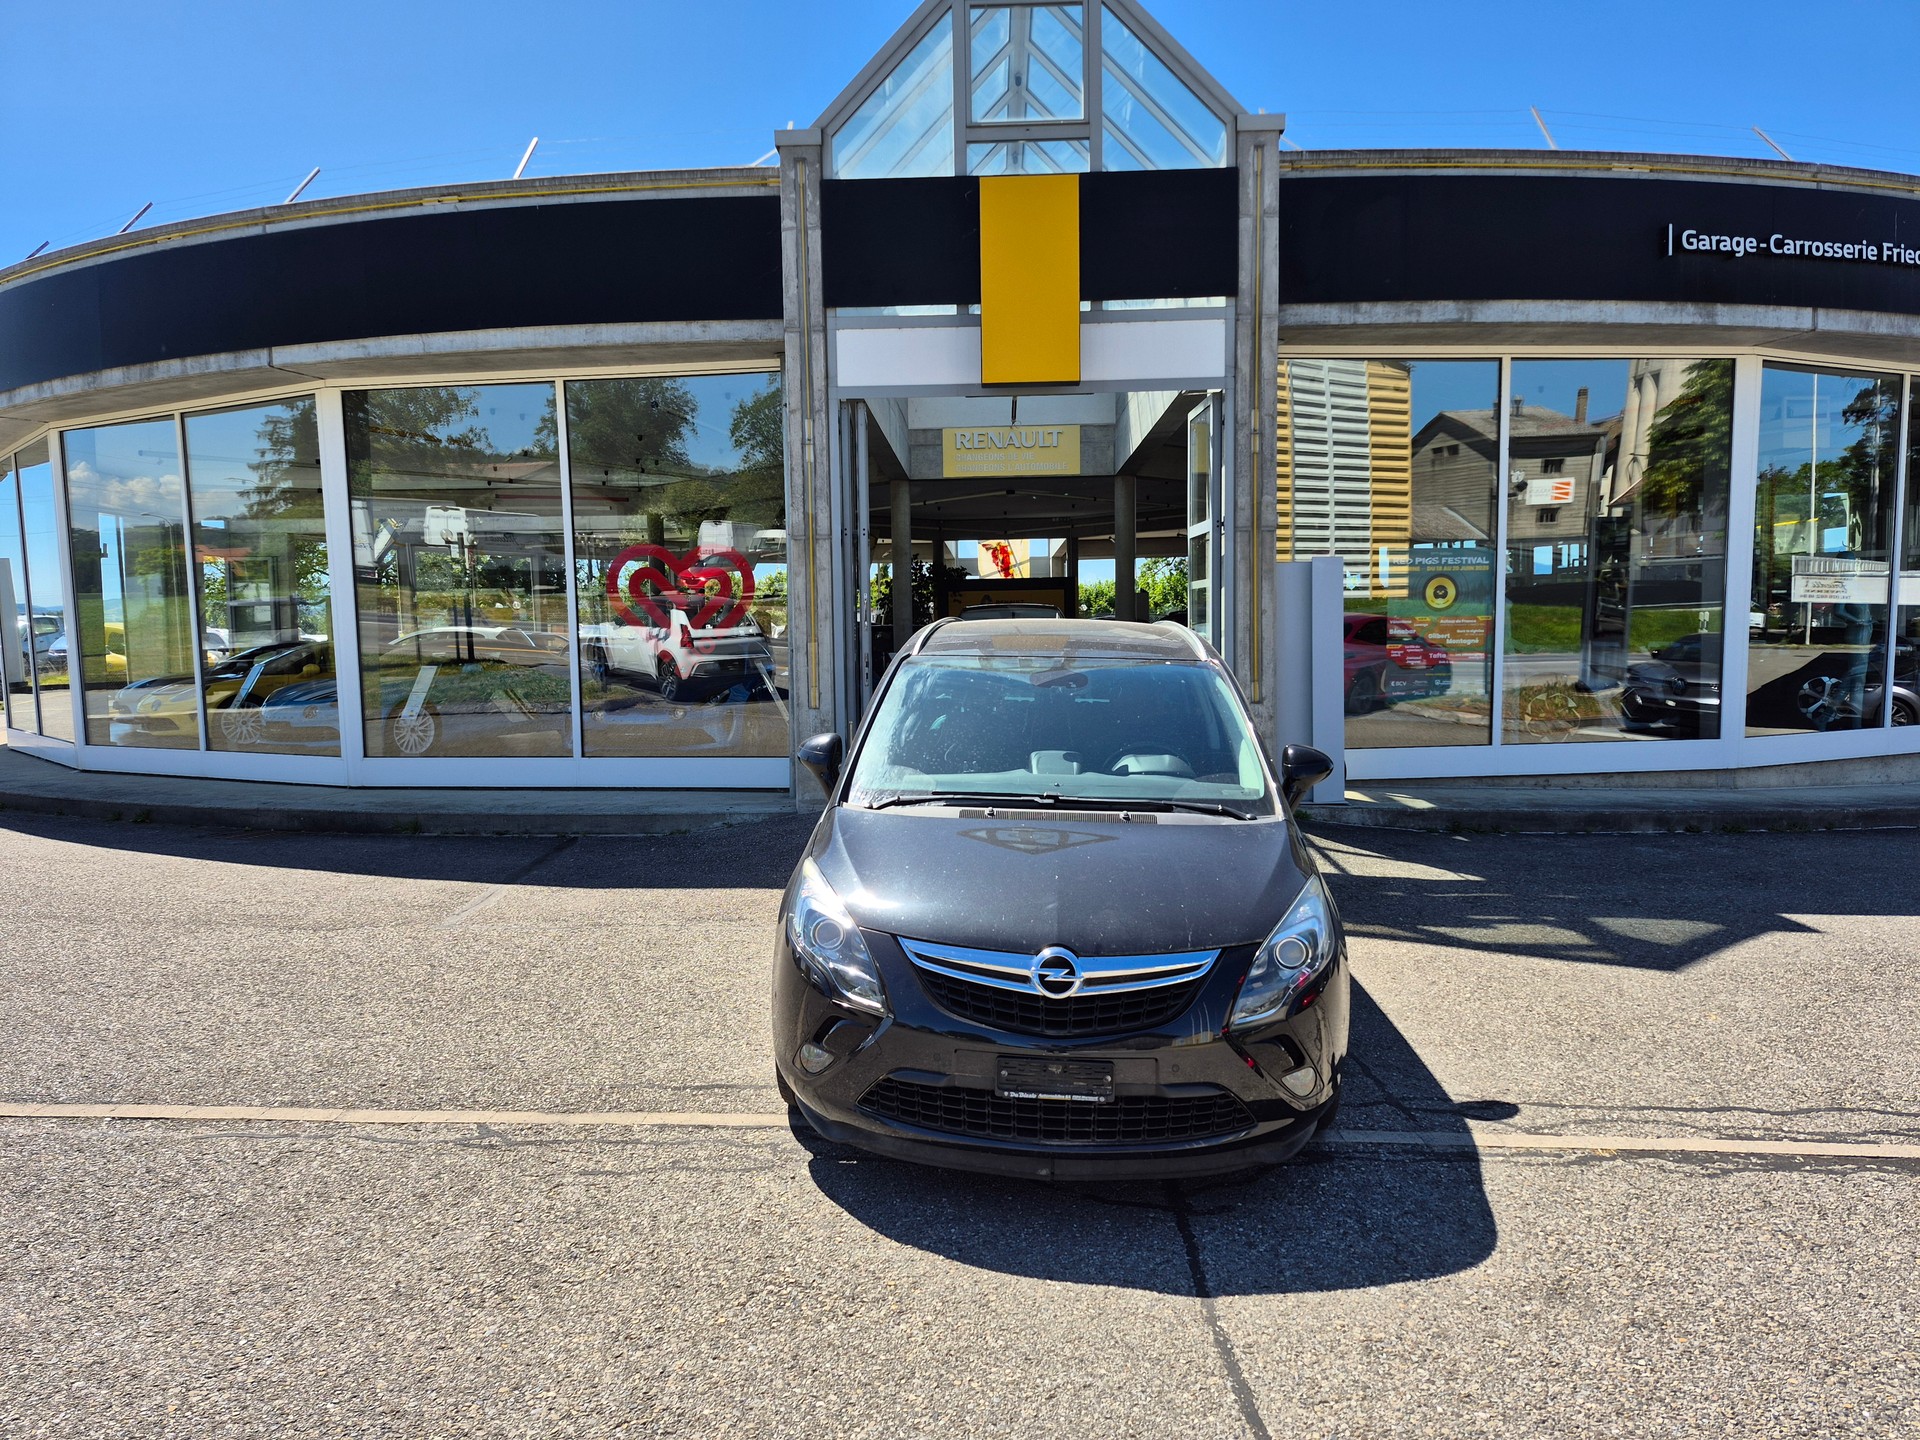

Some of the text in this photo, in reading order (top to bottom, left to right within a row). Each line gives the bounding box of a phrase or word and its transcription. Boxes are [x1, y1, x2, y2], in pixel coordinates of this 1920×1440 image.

[955, 430, 1062, 449] RENAULT
[956, 452, 1036, 461] CHANGEONS DE VIE
[956, 463, 1005, 472] CHANGEONS
[1392, 556, 1490, 565] RED PIGS FESTIVAL
